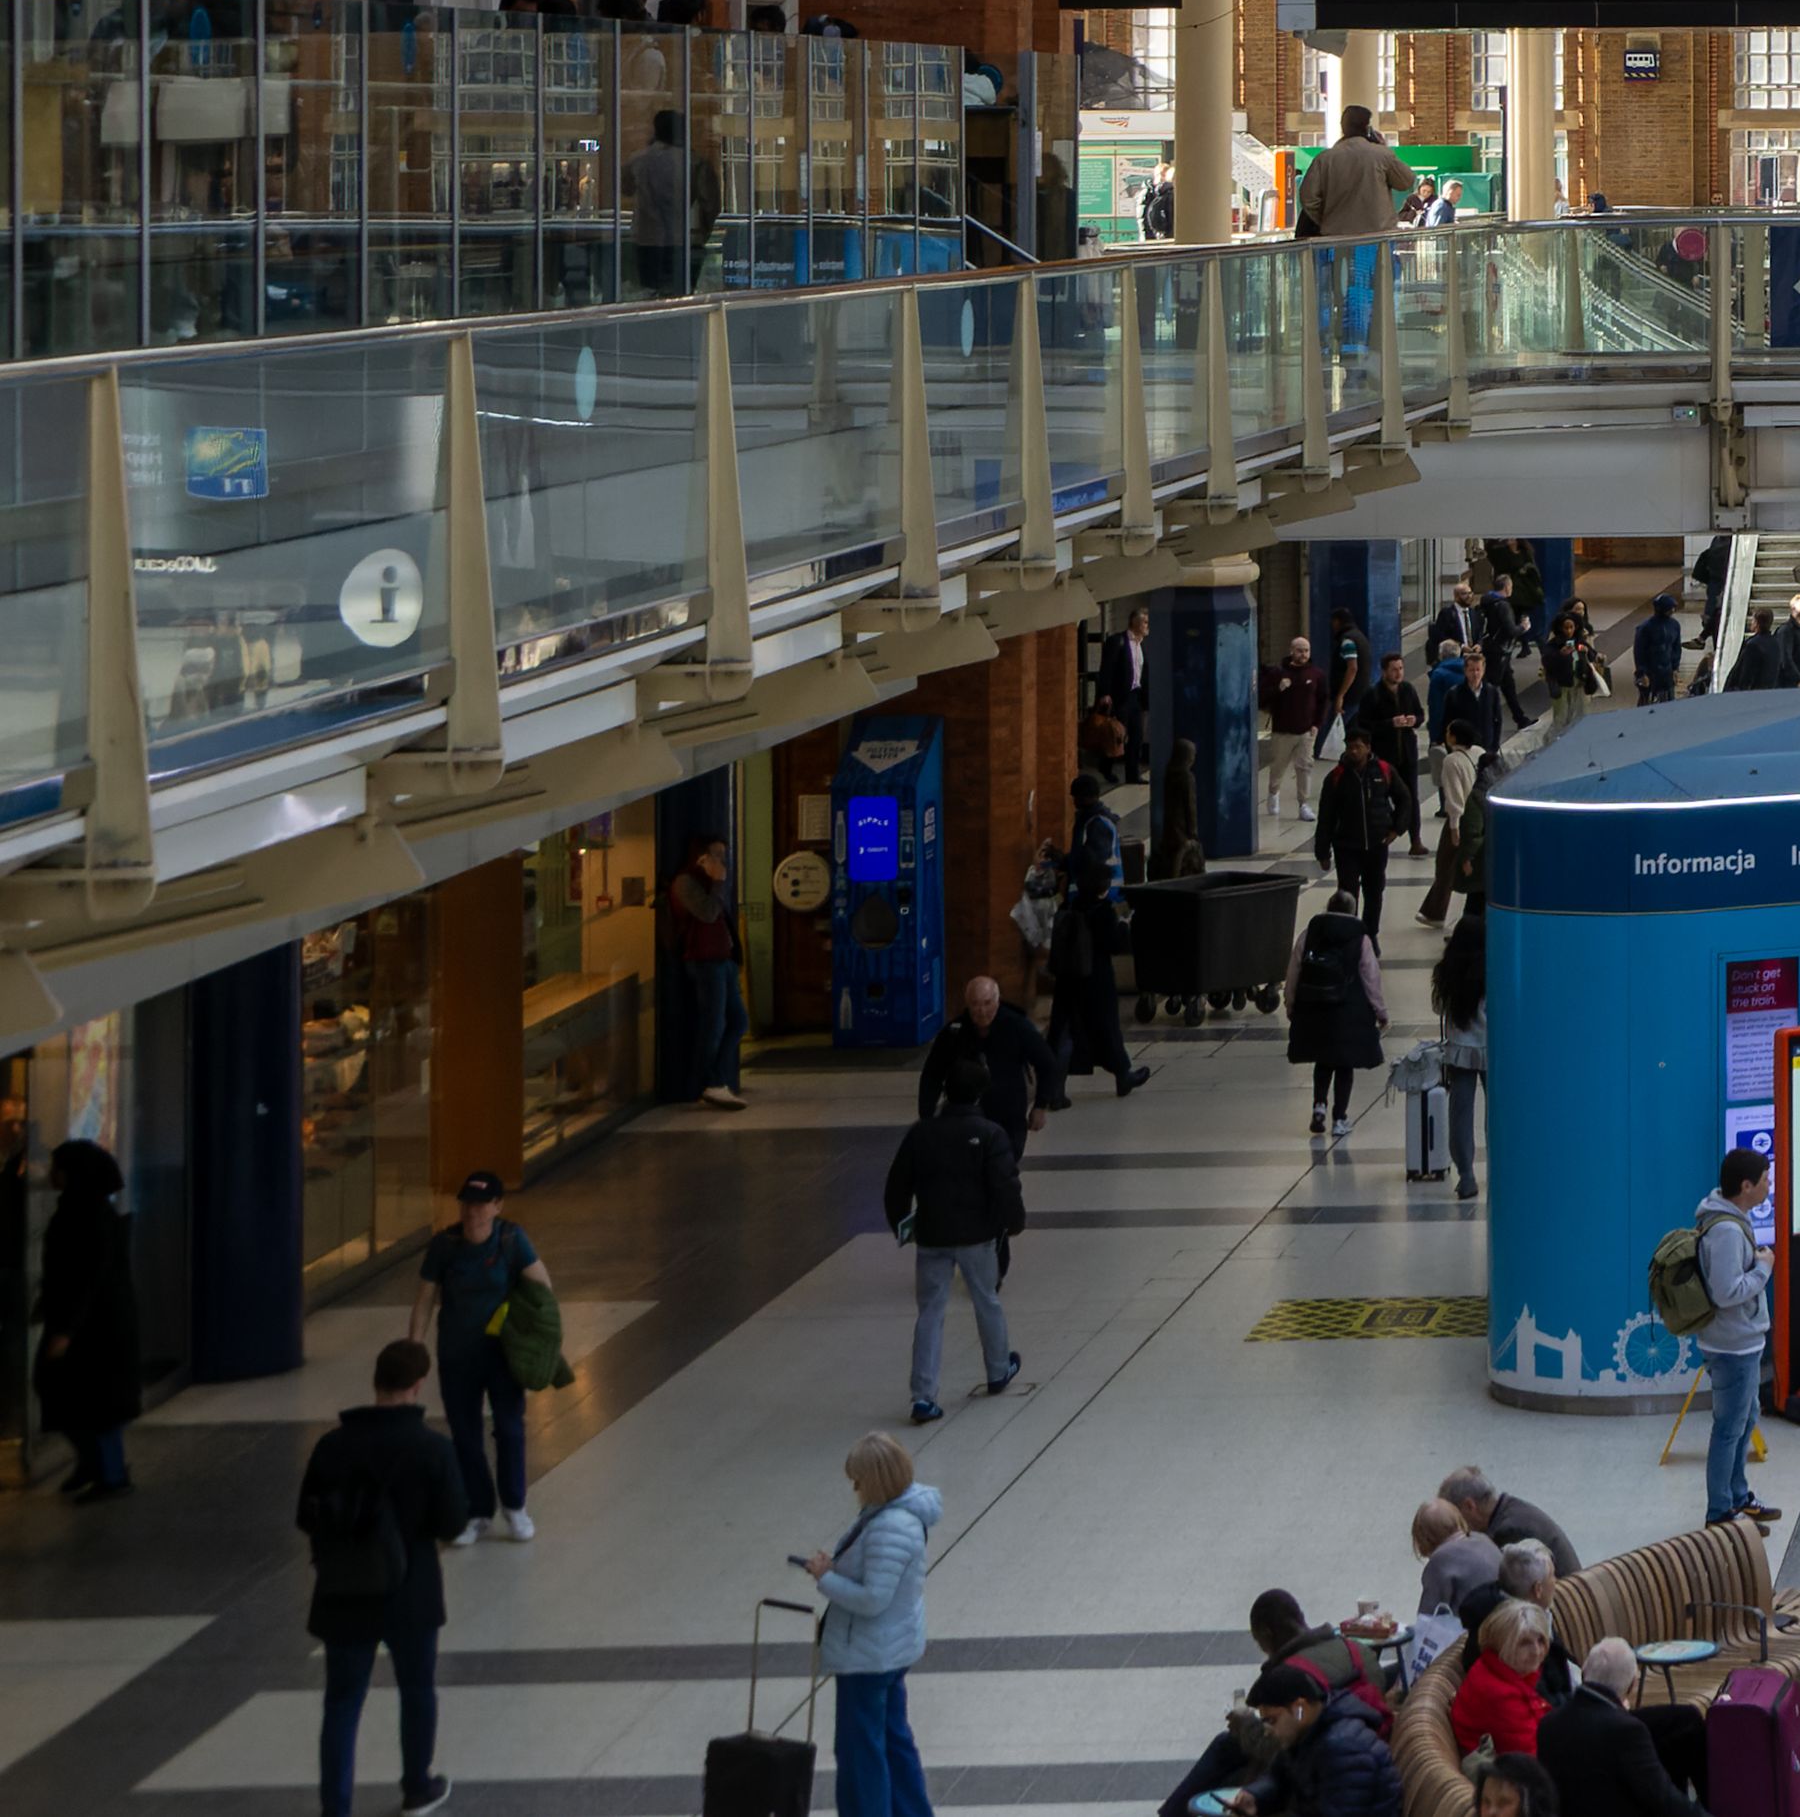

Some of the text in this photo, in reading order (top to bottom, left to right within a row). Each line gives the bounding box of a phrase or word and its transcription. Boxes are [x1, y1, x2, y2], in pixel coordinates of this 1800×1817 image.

[1633, 850, 1756, 878] Informacja
[1731, 967, 1781, 982] Don't get
[1731, 981, 1776, 994] stuck on
[1731, 993, 1777, 1008] the train.
